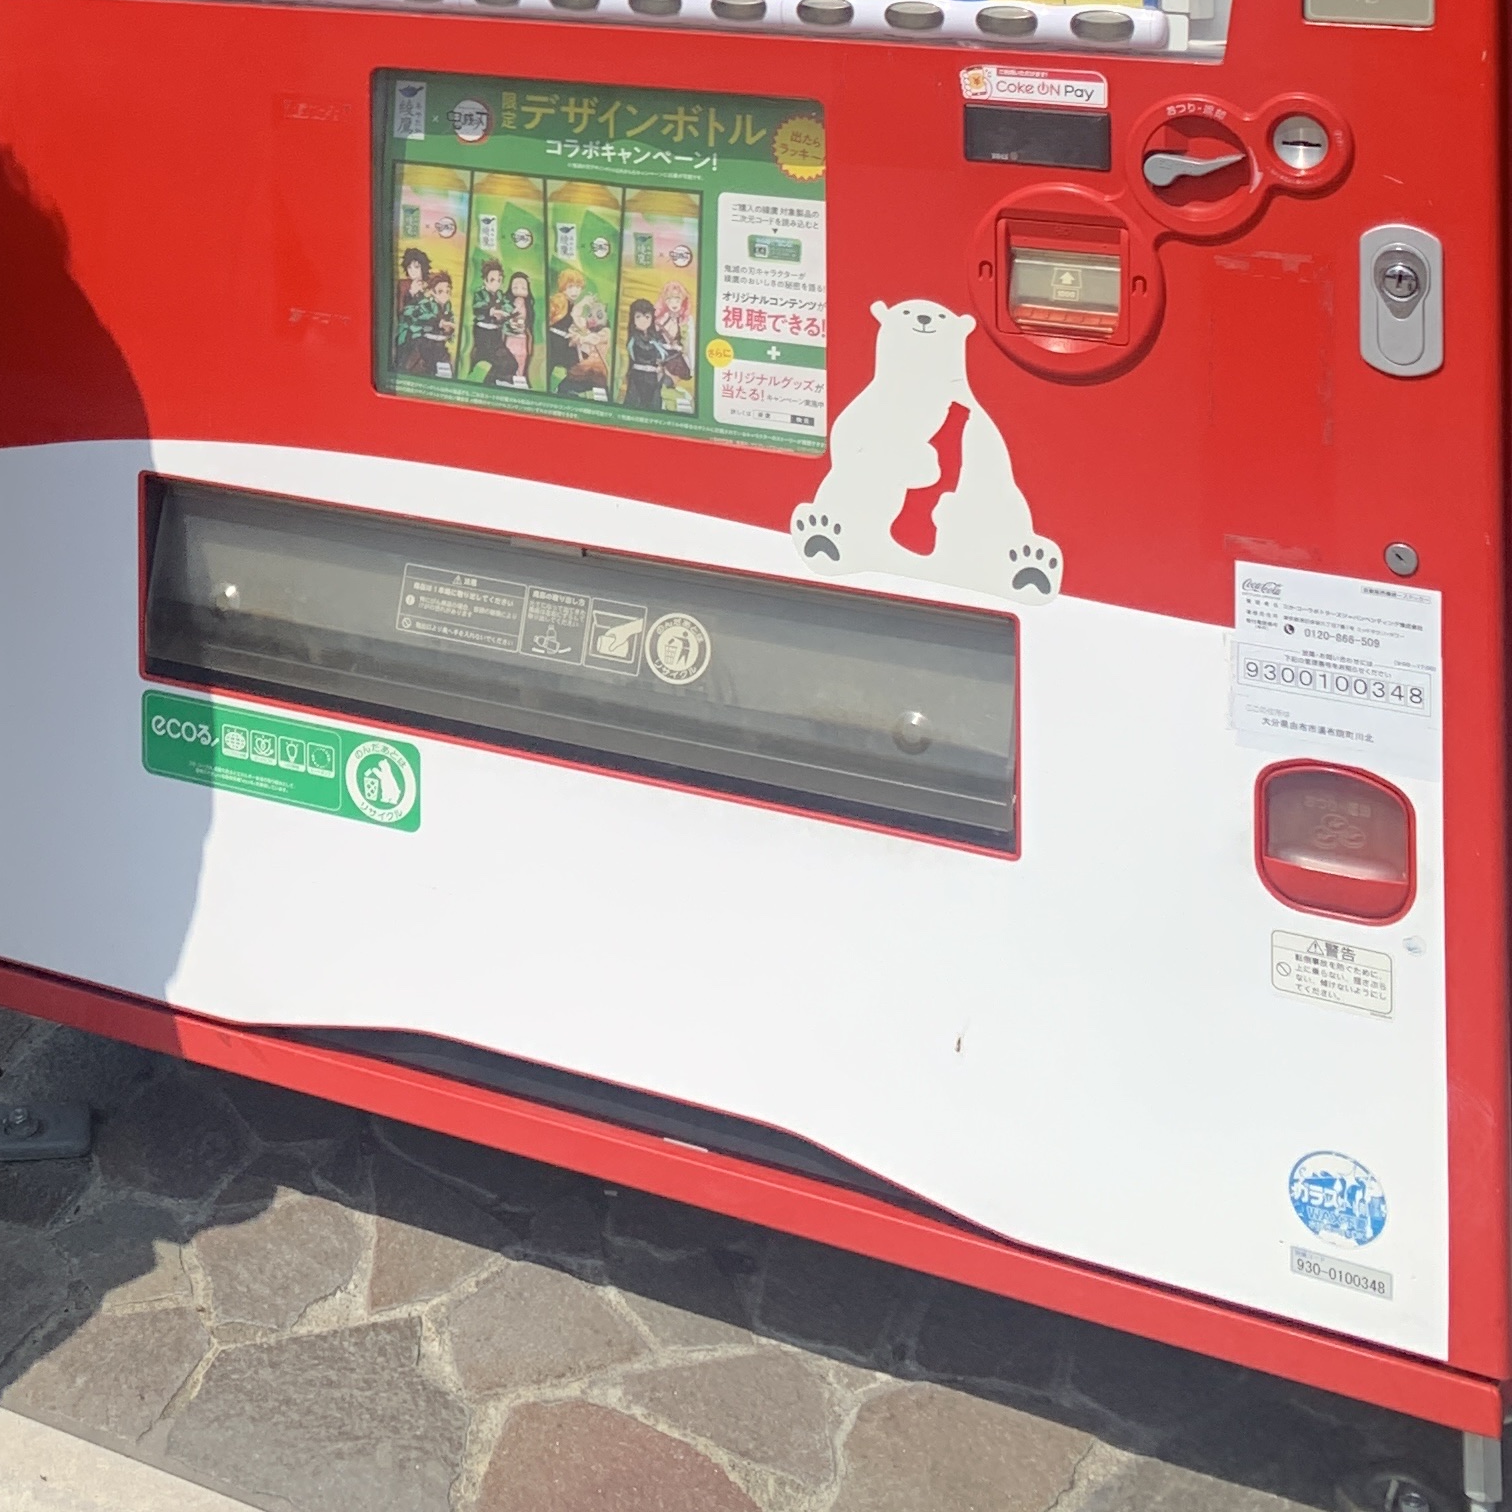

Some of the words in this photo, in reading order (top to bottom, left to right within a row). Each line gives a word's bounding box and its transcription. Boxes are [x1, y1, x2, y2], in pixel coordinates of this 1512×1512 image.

[996, 80, 1034, 94] Coke
[1038, 81, 1061, 96] ON
[1064, 85, 1095, 102] Pay
[521, 93, 768, 148] デザインボトル
[789, 130, 821, 149] 出たら
[545, 139, 719, 172] コラボキャンペーン!
[721, 306, 826, 338] 視聴できる!
[707, 346, 732, 360] さらに
[721, 370, 826, 393] オリジナルグッズが
[721, 384, 766, 402] 当たる!
[1245, 661, 1424, 705] 9300100348
[359, 800, 404, 822] リサイクル
[1296, 1258, 1386, 1296] 930-0100348
